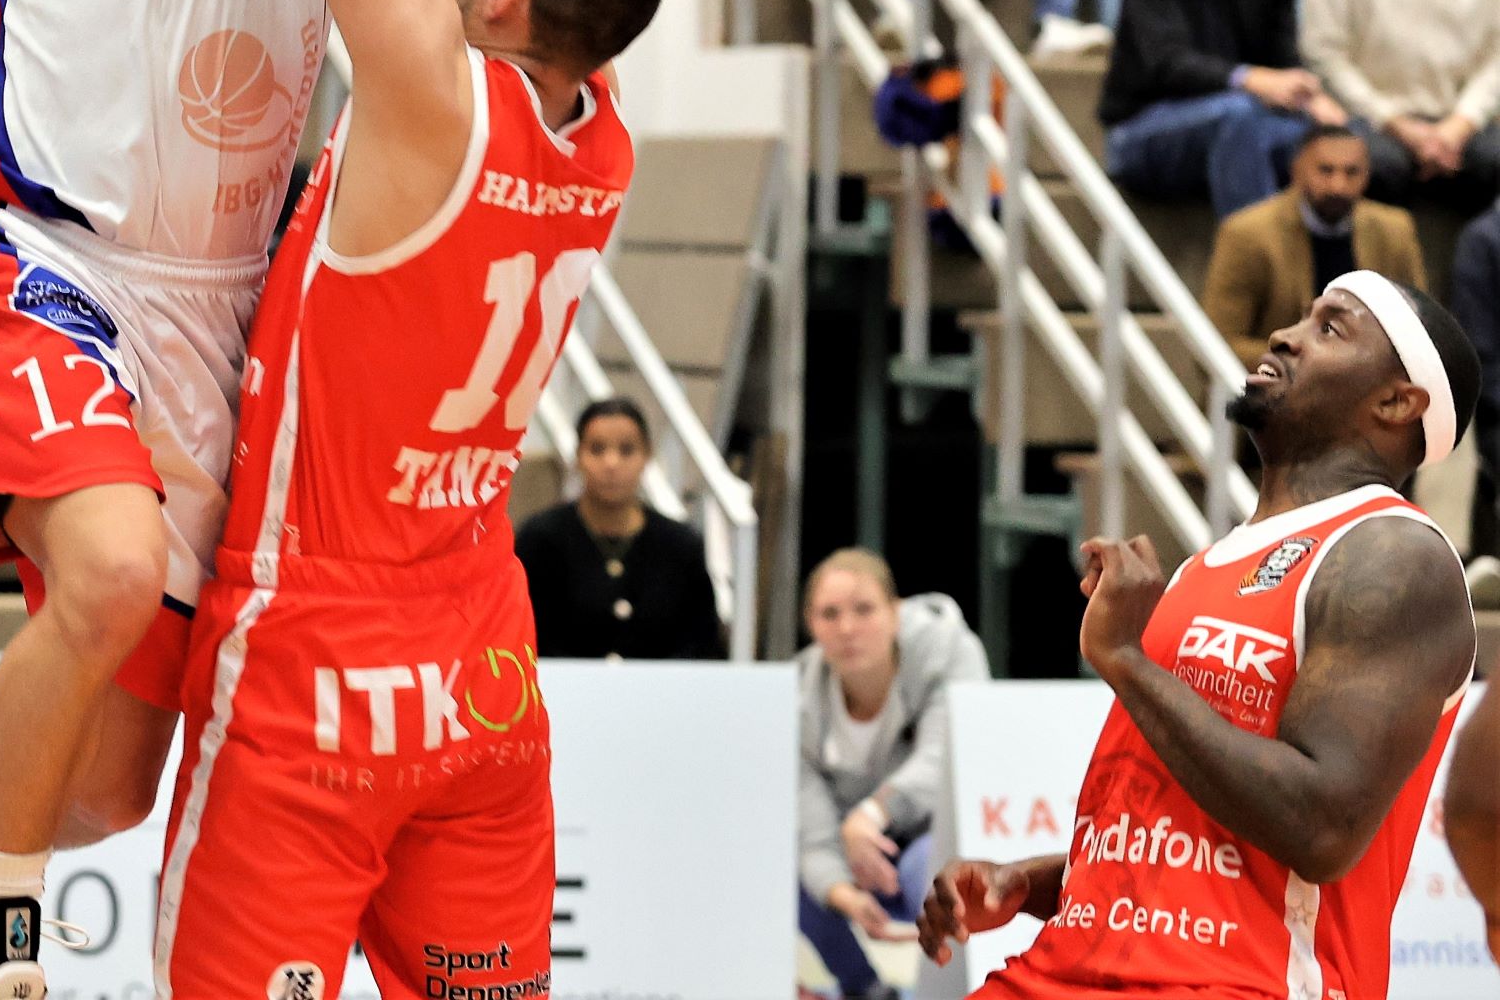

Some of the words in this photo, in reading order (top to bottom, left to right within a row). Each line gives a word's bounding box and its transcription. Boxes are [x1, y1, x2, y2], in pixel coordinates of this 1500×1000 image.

[11, 354, 131, 443] 12
[1177, 616, 1288, 684] DAK
[1108, 897, 1239, 947] Center
[423, 942, 512, 976] Sport
